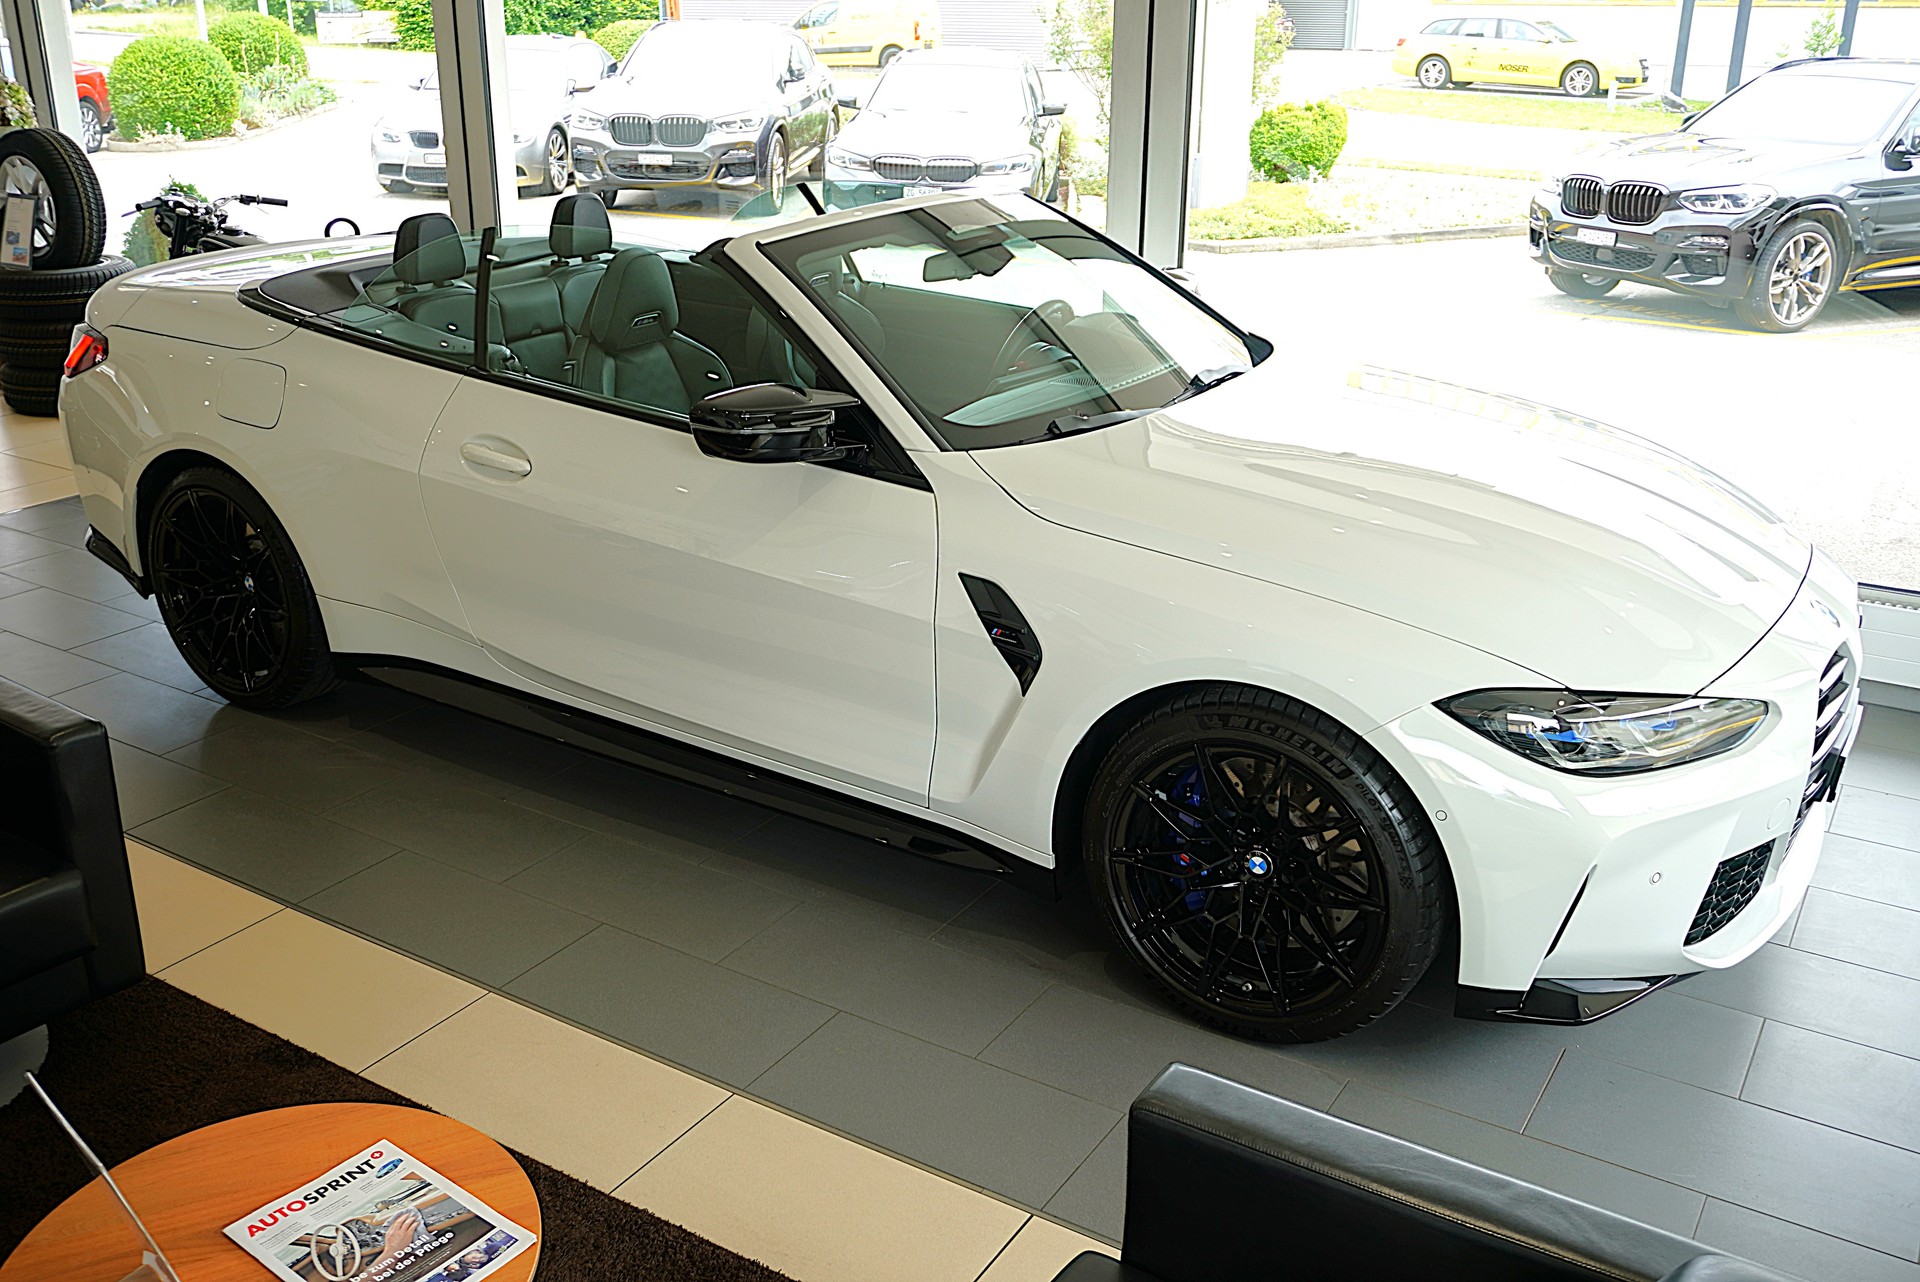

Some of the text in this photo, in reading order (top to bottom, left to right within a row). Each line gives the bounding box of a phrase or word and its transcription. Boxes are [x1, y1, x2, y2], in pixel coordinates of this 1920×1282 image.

[1498, 63, 1528, 73] NOSER
[1228, 716, 1348, 773] MICHELIN
[1355, 783, 1383, 813] PILOT
[246, 1159, 376, 1238] AUTOSPRINT
[369, 1257, 395, 1273] zum
[394, 1234, 430, 1259] Detail
[373, 1232, 454, 1281] bei der Pflege
